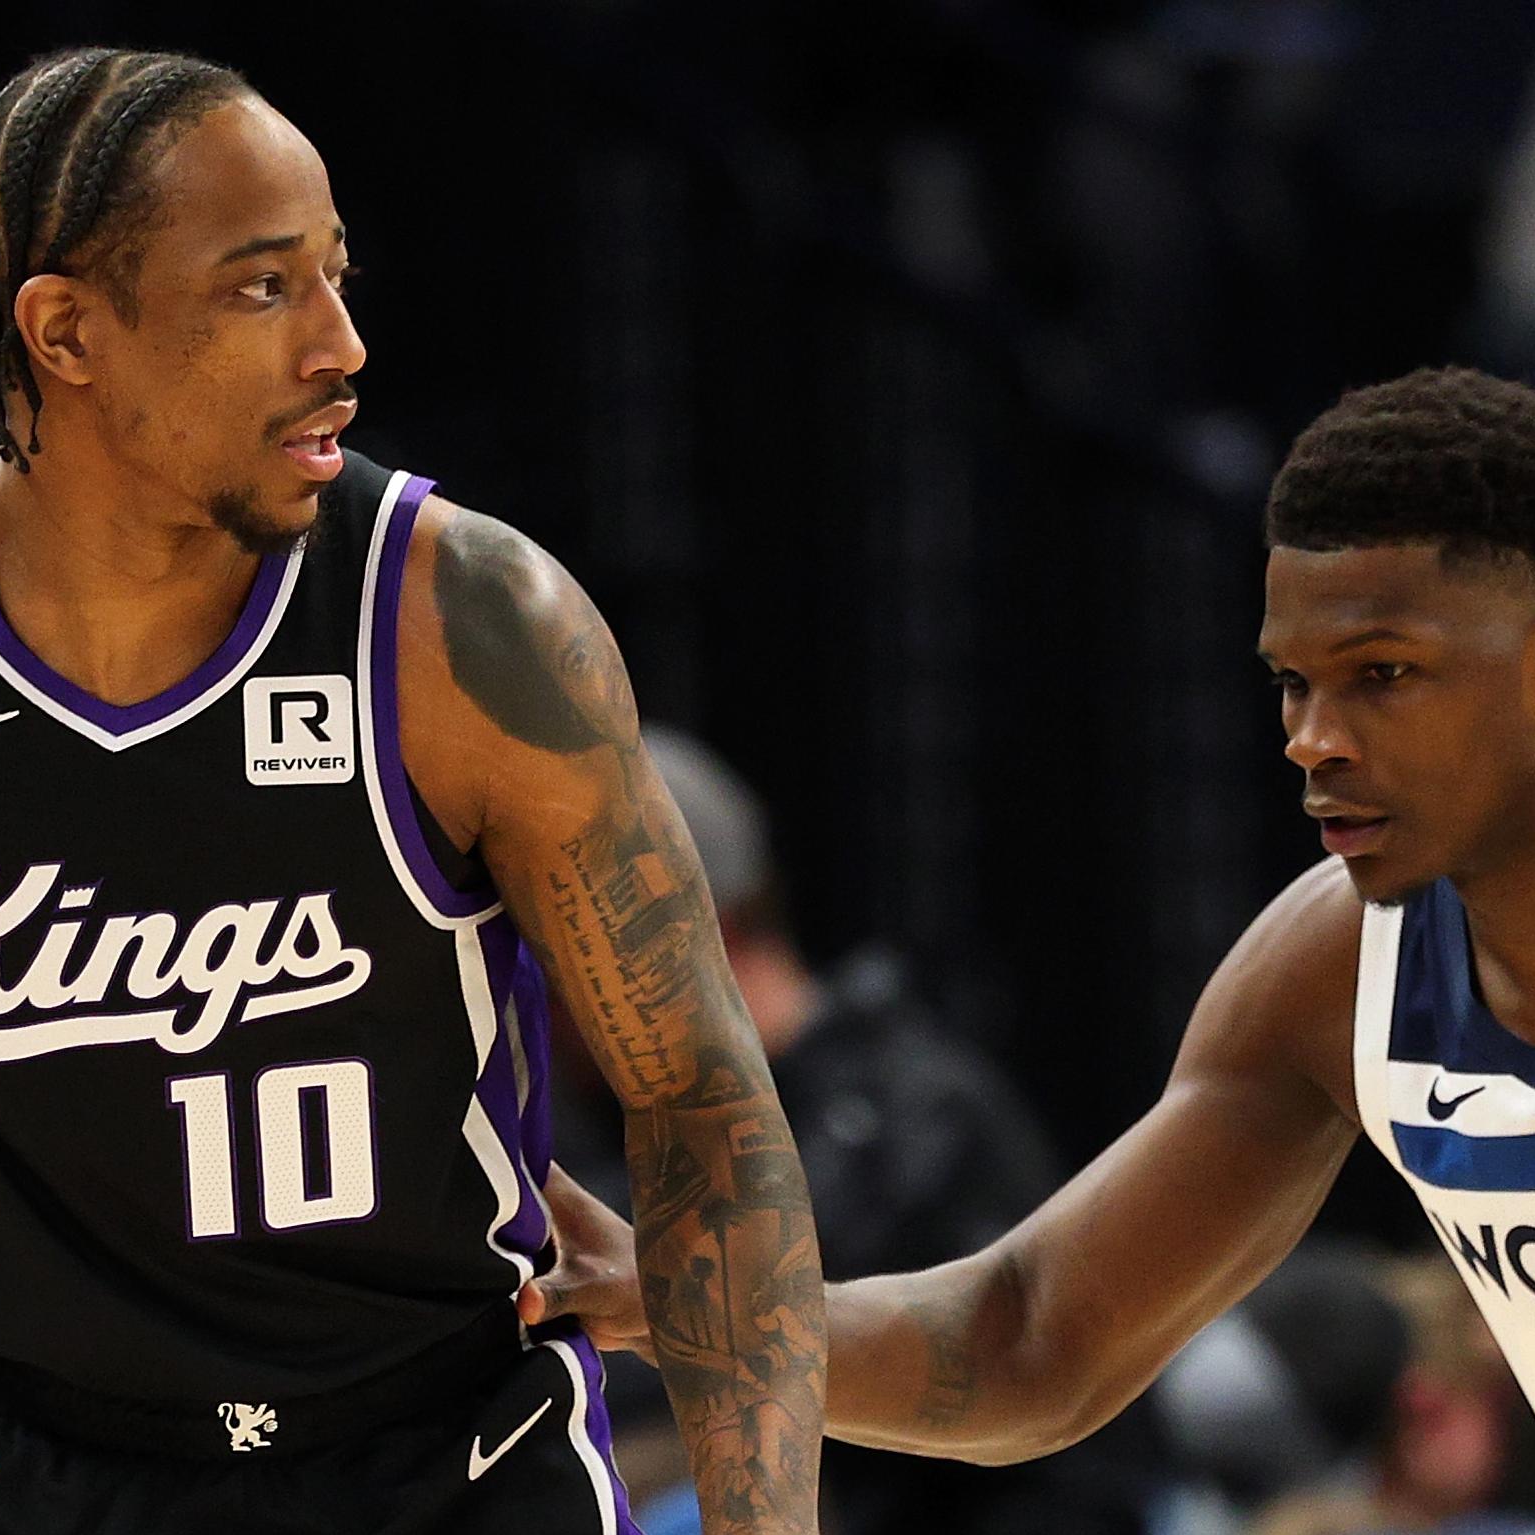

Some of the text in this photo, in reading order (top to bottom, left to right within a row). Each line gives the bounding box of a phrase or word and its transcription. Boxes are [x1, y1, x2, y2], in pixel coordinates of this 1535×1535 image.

[269, 690, 332, 744] R
[253, 756, 346, 772] REVIVER
[167, 1057, 380, 1242] 10
